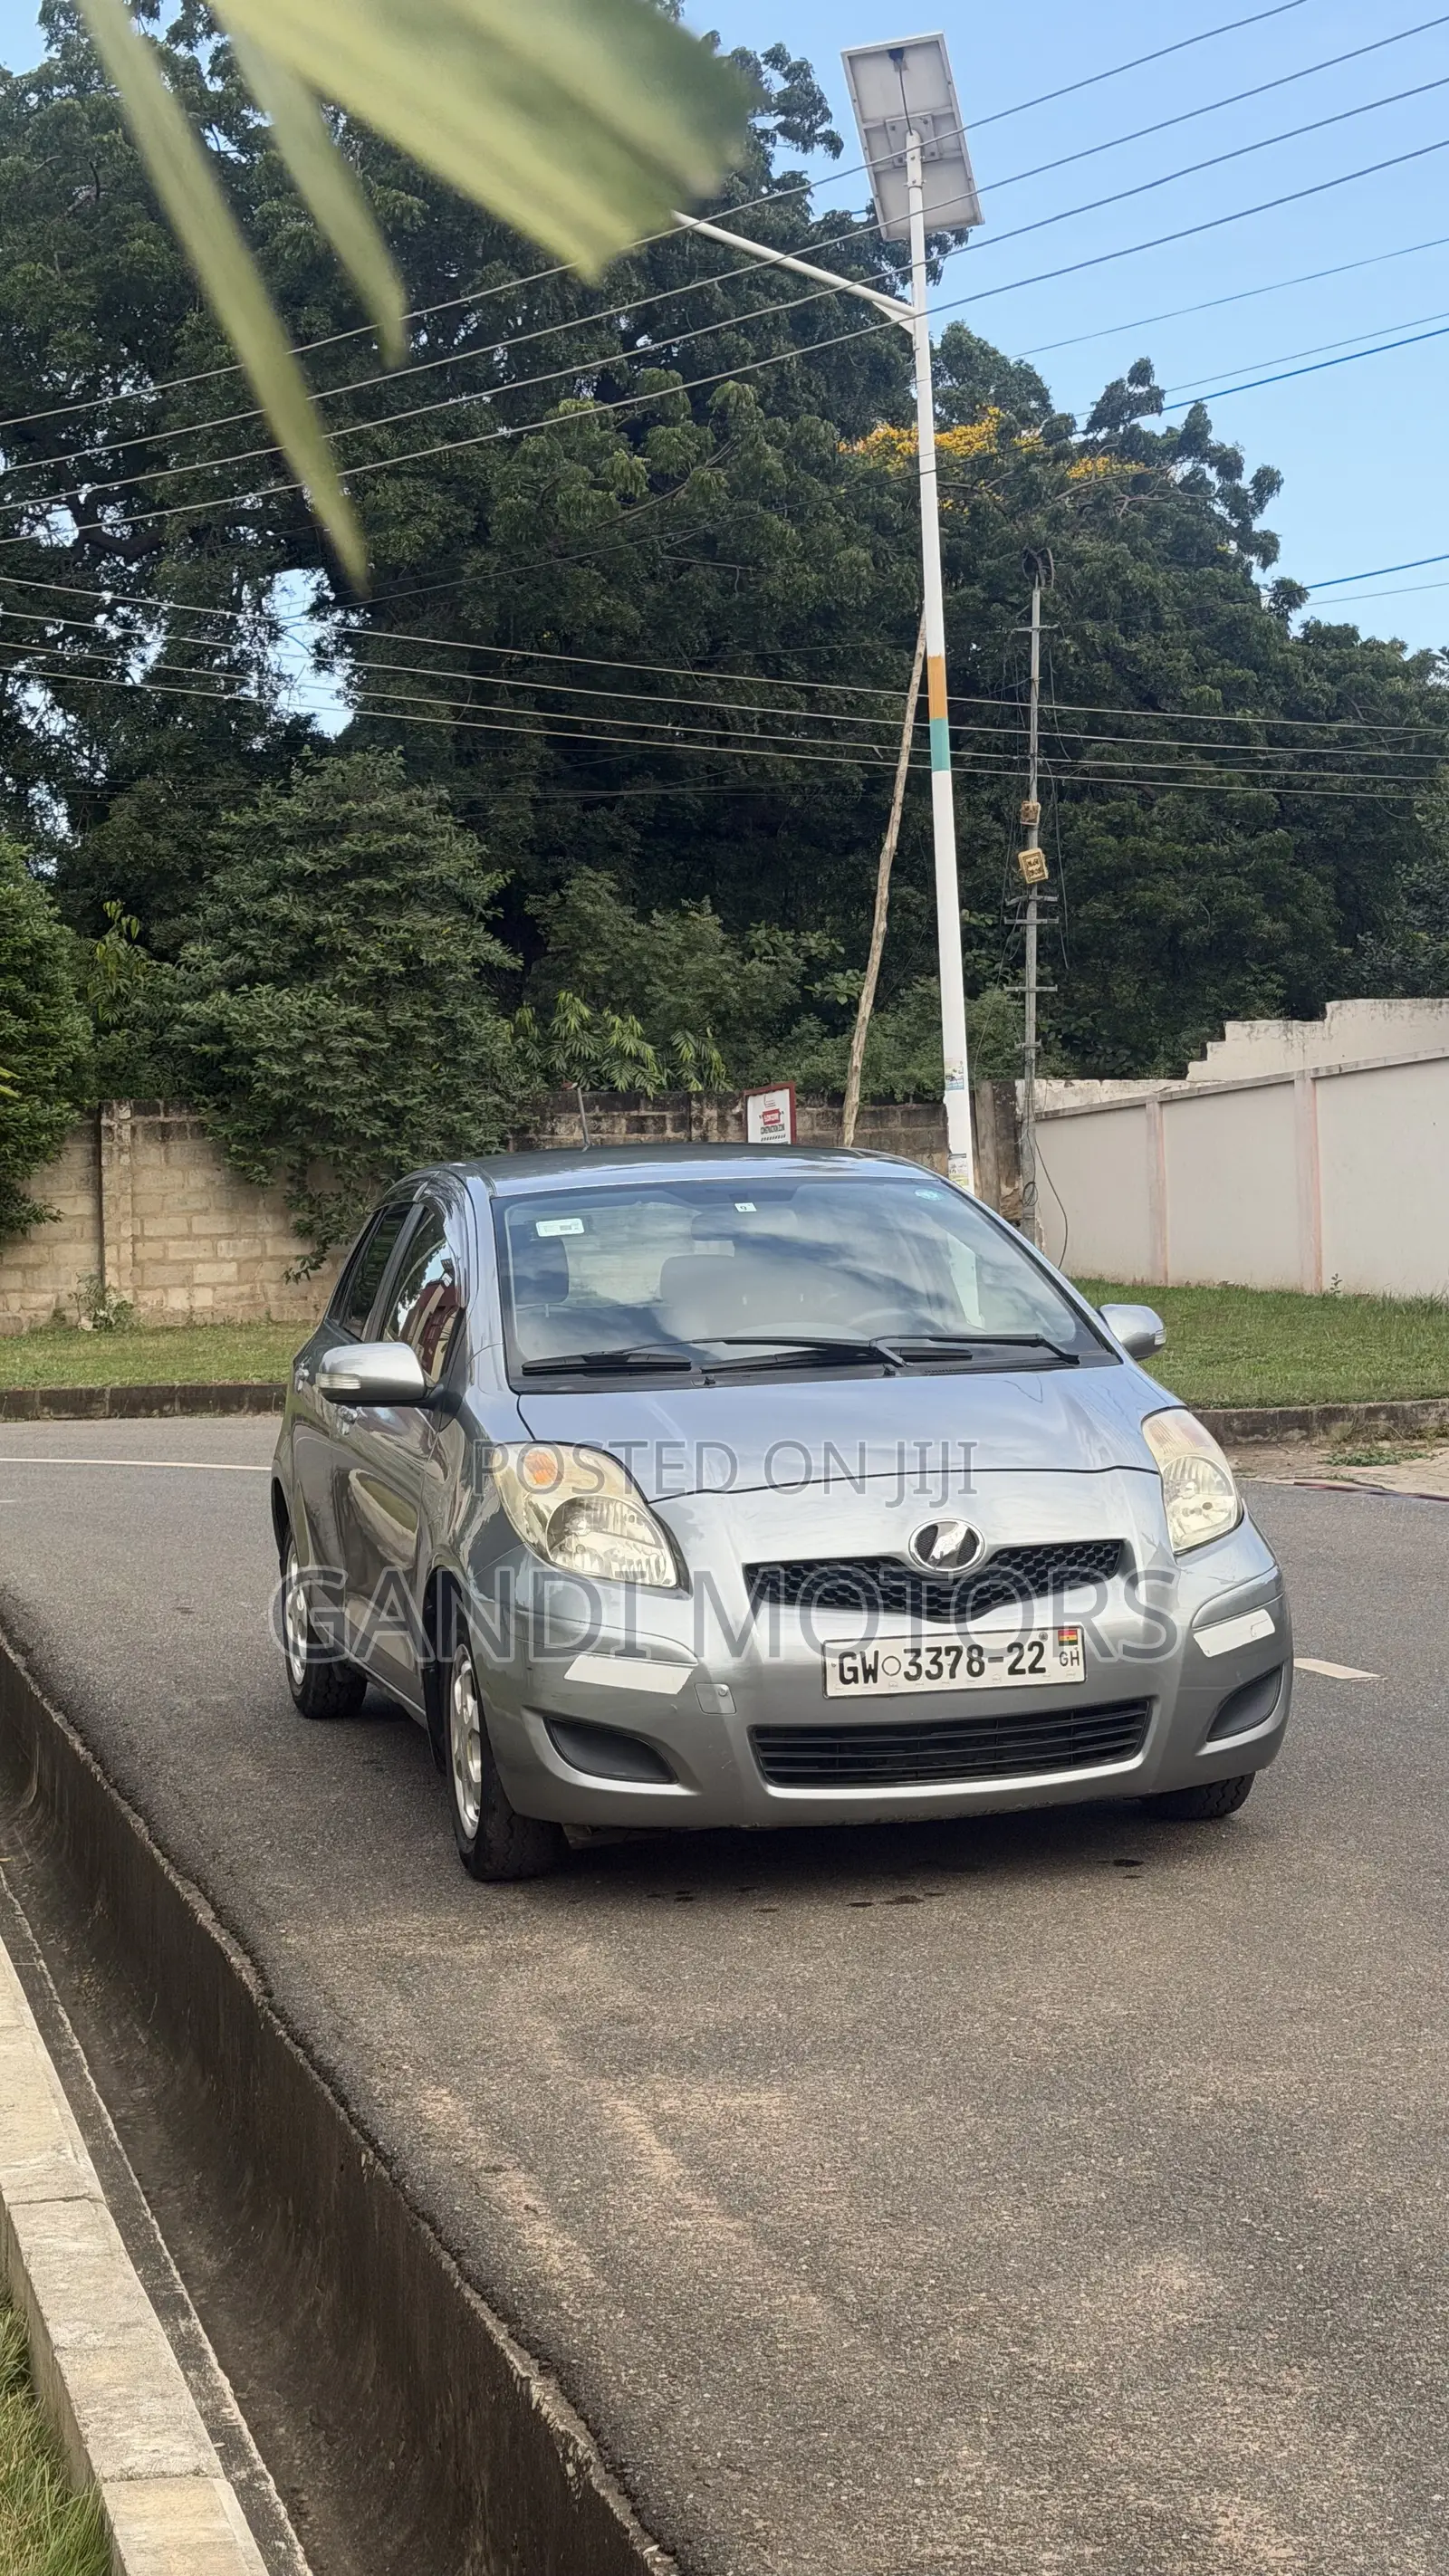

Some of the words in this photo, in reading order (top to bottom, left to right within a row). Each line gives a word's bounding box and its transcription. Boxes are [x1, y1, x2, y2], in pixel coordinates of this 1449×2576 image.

[838, 1650, 879, 1685] GW
[903, 1641, 1046, 1681] 3378-22
[1059, 1651, 1080, 1667] GH
